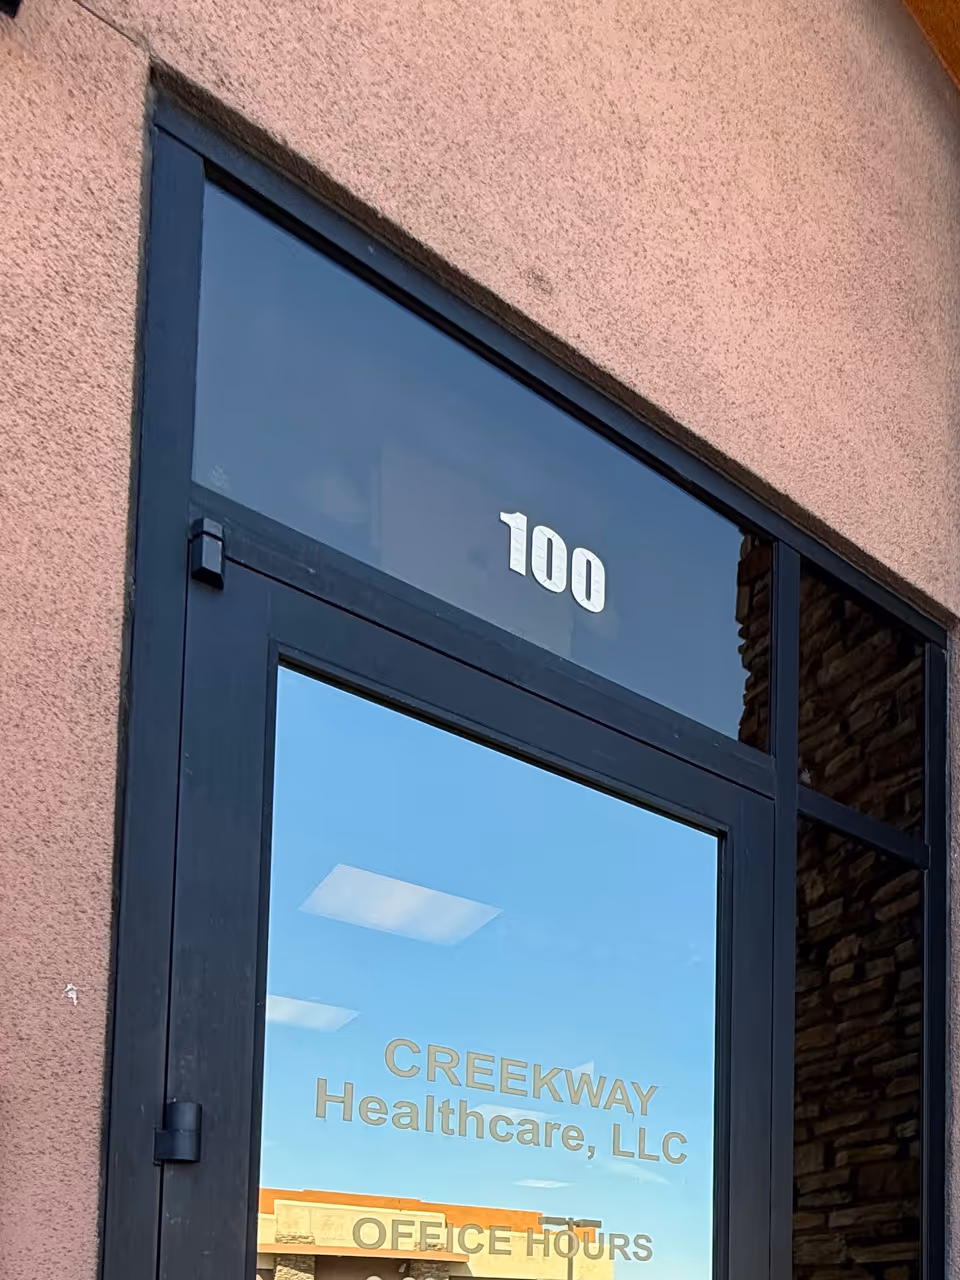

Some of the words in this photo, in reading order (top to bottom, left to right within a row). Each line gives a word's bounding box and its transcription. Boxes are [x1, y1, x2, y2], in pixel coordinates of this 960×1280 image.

[499, 511, 606, 613] 100
[384, 1038, 658, 1117] CREEKWAY
[315, 1077, 596, 1160] Healthcare,
[612, 1123, 688, 1165] LLC
[352, 1217, 512, 1256] OFFICE
[526, 1227, 654, 1261] HOURS
